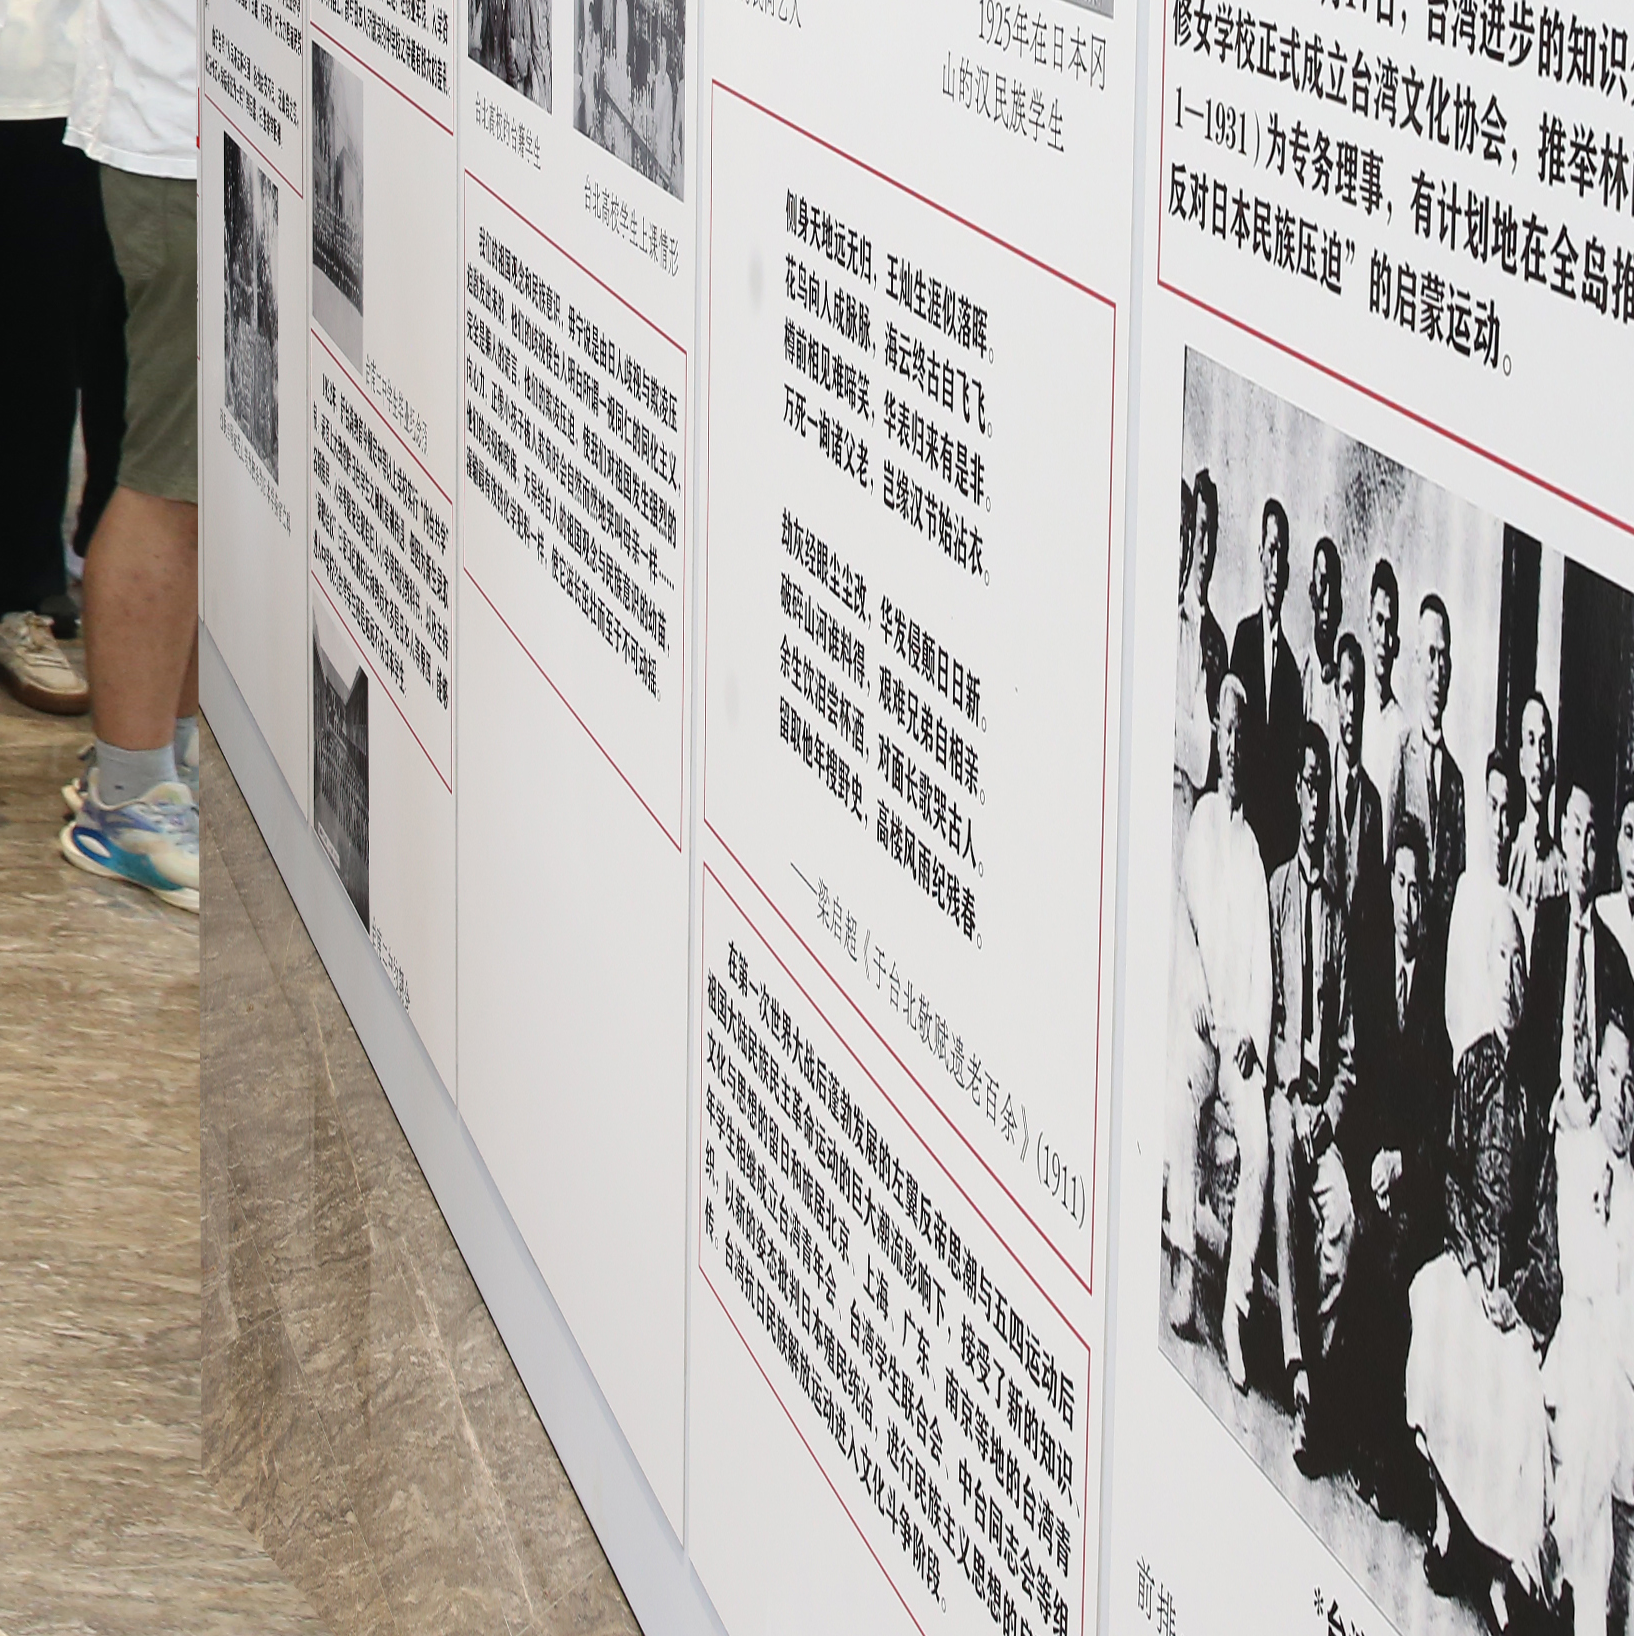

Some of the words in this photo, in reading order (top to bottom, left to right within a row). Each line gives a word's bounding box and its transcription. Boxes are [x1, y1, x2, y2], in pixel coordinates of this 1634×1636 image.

[942, 50, 1064, 154] 山的汉民族学生
